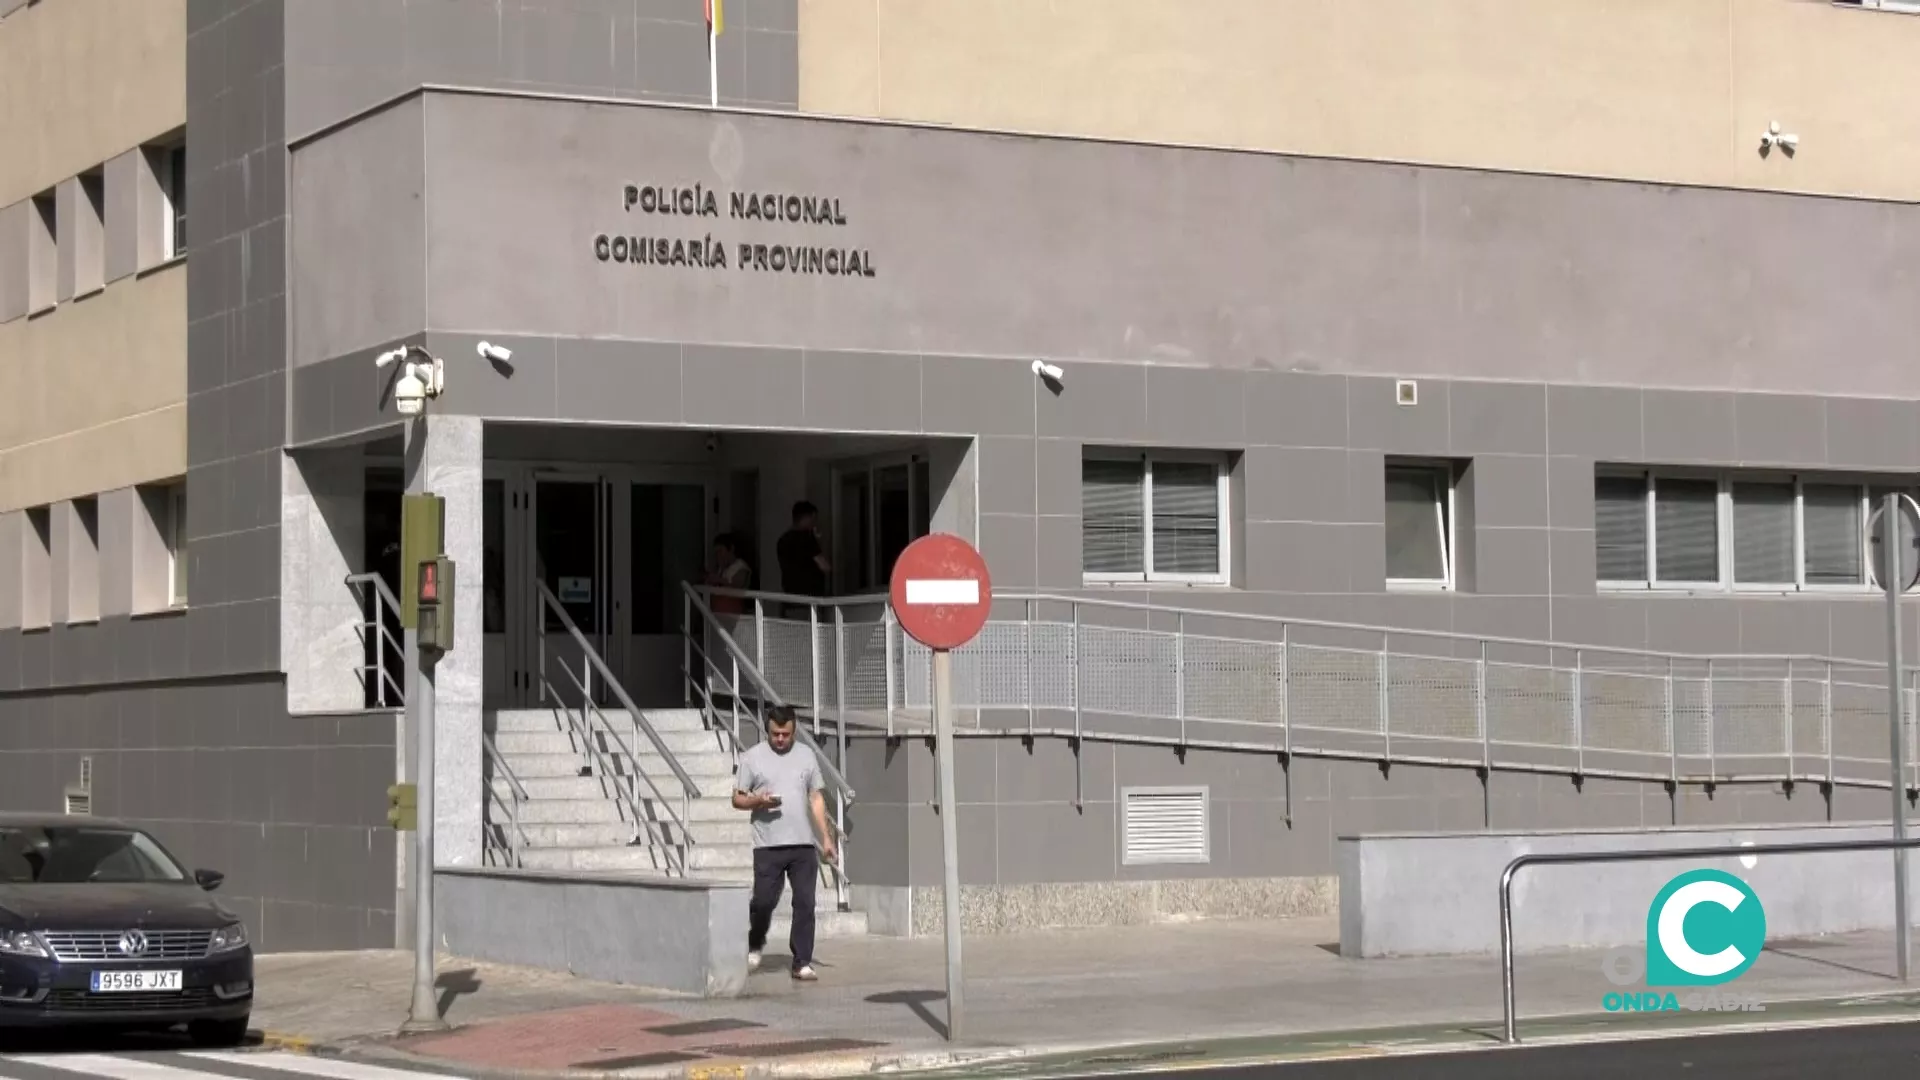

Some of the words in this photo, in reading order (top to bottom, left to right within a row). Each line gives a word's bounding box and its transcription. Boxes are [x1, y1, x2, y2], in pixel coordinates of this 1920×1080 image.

[624, 181, 718, 217] POLICÍA
[729, 191, 847, 225] NACIONAL
[594, 232, 727, 269] COMISARÍA
[737, 243, 876, 277] PROVINCIAL
[102, 973, 144, 989] 9596
[149, 972, 179, 988] JXT
